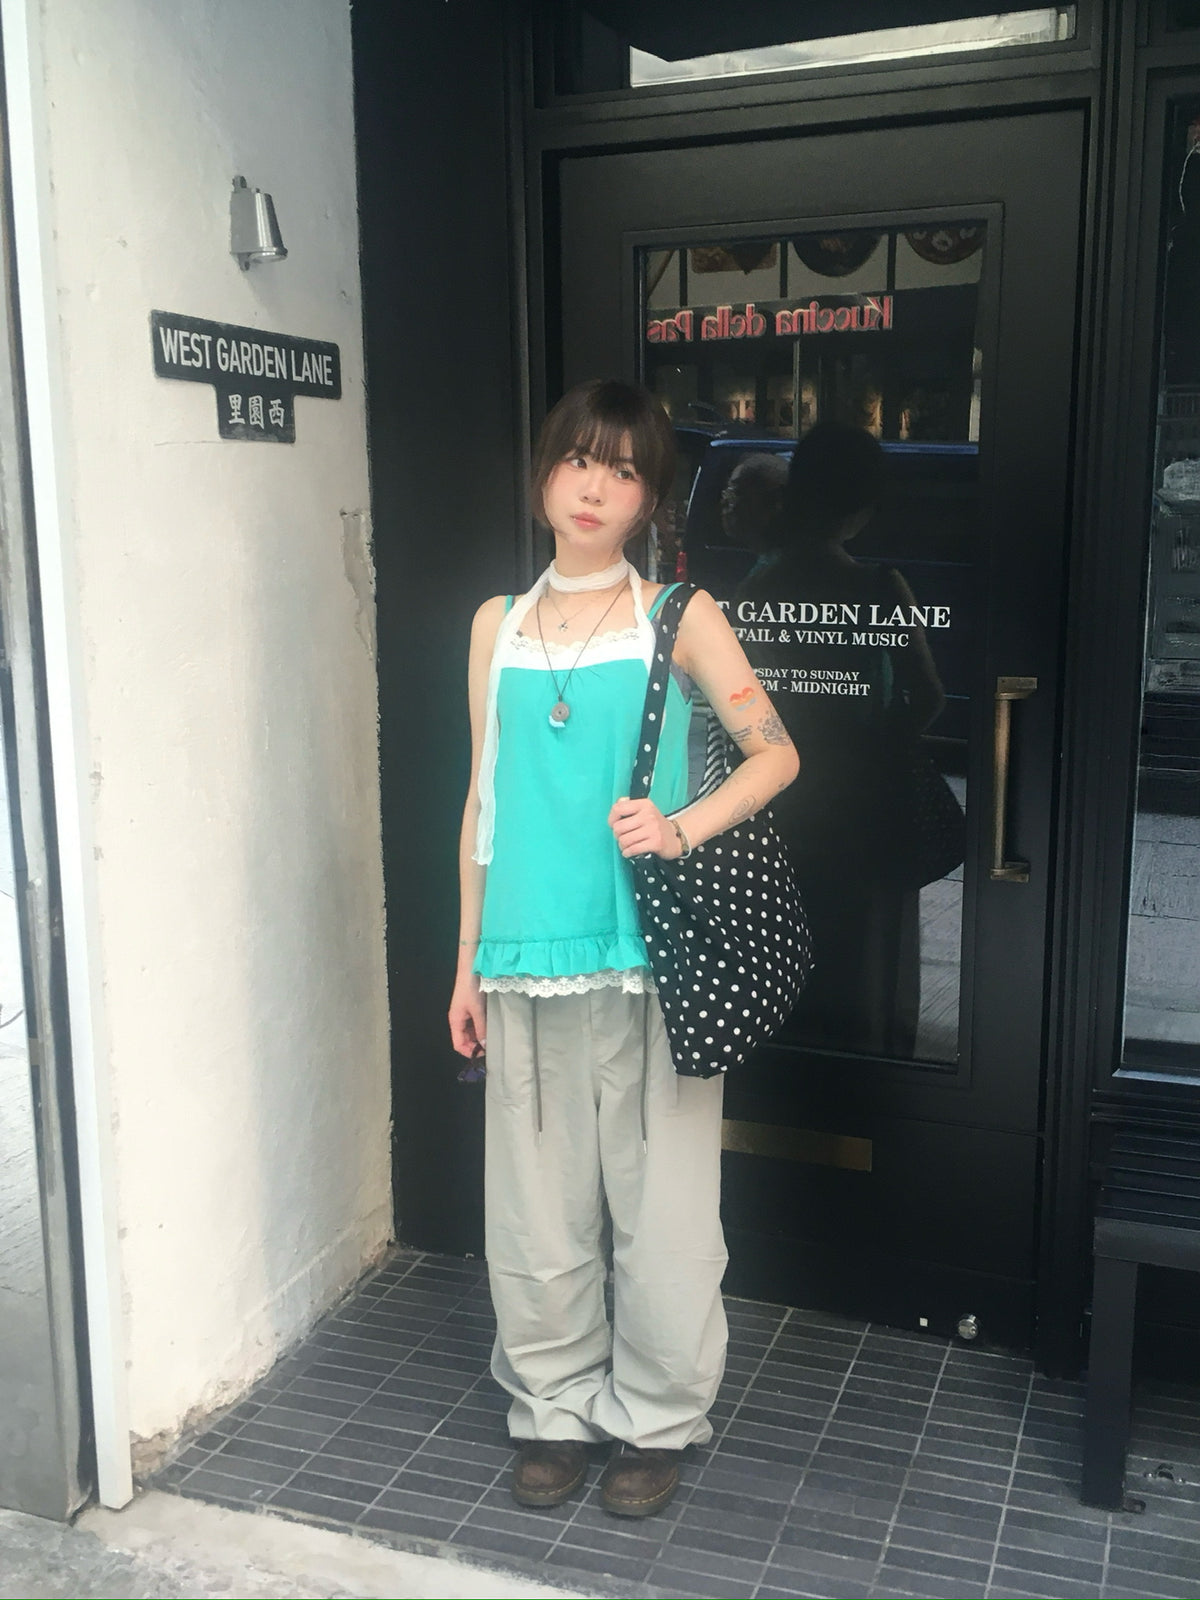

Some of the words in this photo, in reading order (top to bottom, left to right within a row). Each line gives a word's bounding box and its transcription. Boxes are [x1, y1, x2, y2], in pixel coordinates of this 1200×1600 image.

[159, 326, 212, 369] WEST
[216, 337, 287, 380] GARDEN
[291, 350, 334, 386] LANE
[737, 601, 861, 625] GARDEN
[868, 604, 951, 628] LANE
[731, 627, 774, 642] TAIL
[778, 629, 791, 643] &
[795, 630, 847, 645] VINYL
[852, 633, 909, 647] MUSIC
[753, 668, 788, 679] SDAY
[790, 669, 807, 679] TO
[810, 670, 860, 681] SUNDAY
[790, 681, 871, 696] MIDNIGHT
